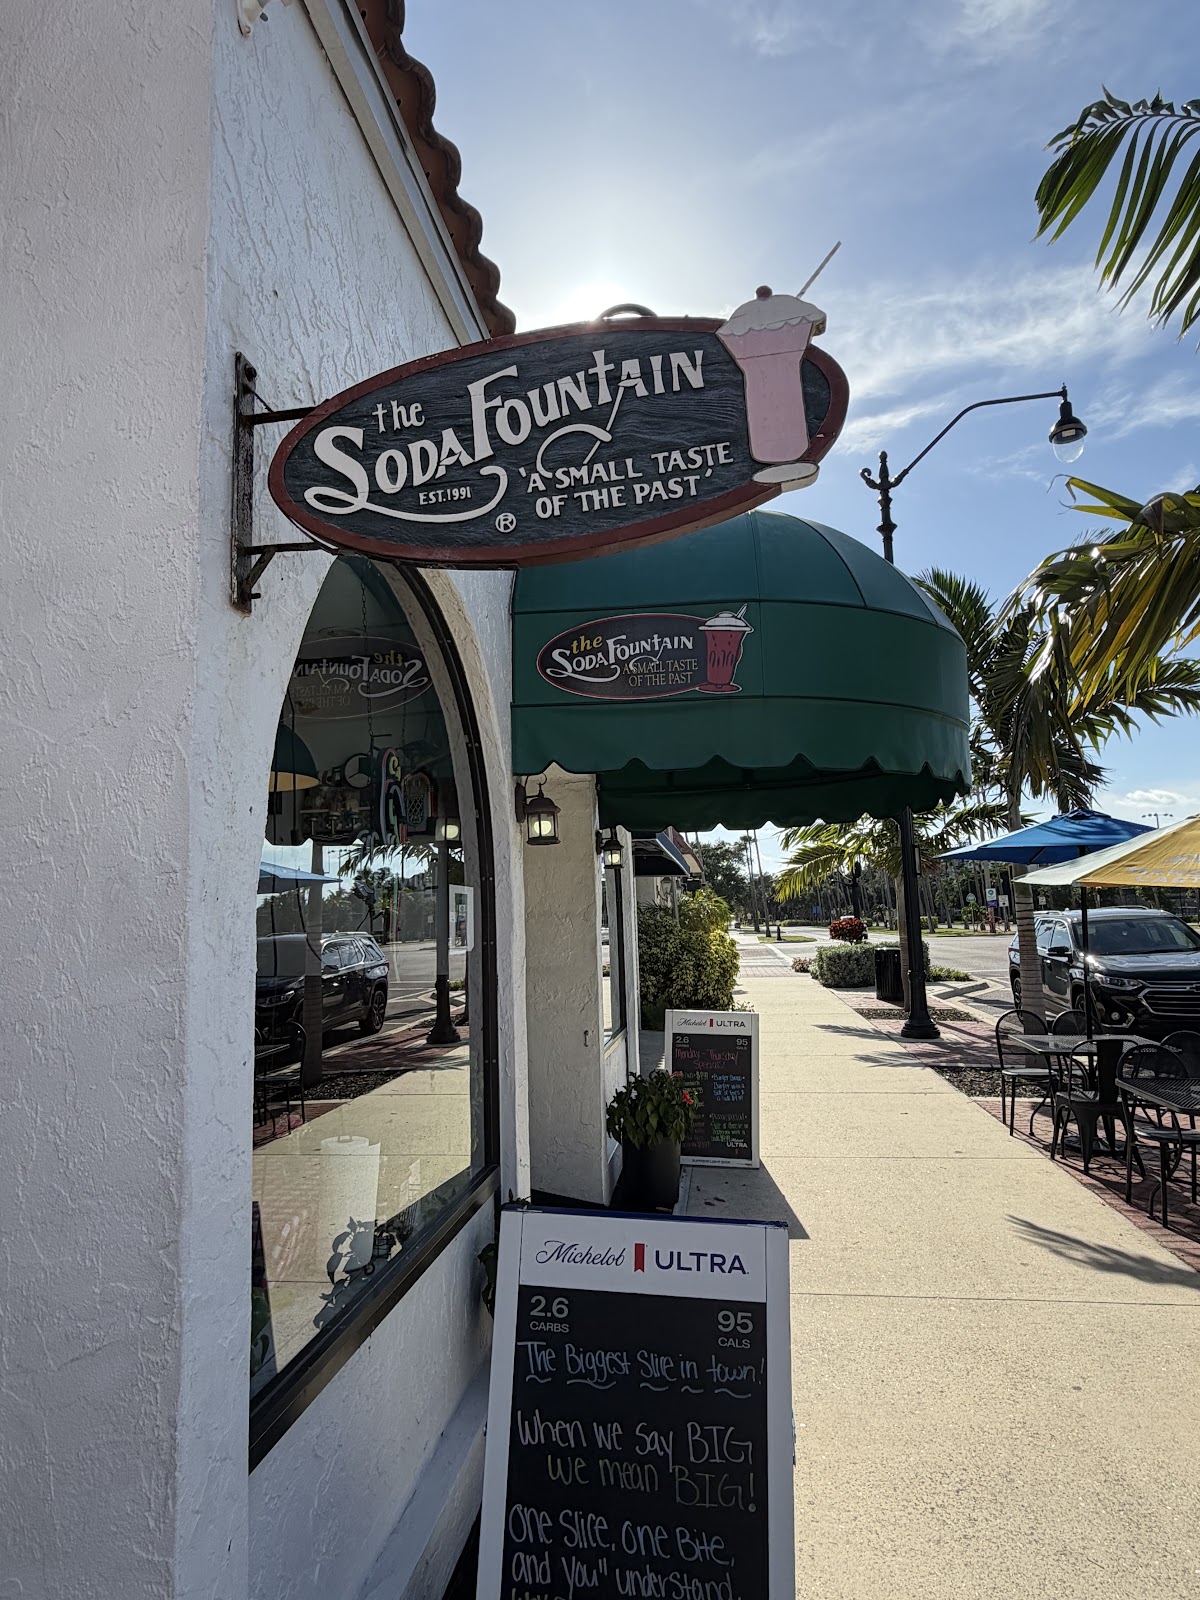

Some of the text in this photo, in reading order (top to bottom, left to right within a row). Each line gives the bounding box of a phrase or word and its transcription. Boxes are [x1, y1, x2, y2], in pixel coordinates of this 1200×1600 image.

[373, 400, 426, 432] the
[554, 457, 644, 487] SMALL
[650, 442, 735, 470] TASTE
[418, 486, 472, 506] EST.1991
[535, 495, 568, 519] OF
[574, 488, 627, 512] THE
[570, 635, 603, 655] the
[666, 658, 698, 671] TASTE
[628, 672, 693, 687] OF THE PAST
[716, 1020, 746, 1028] ULTRA
[675, 1036, 748, 1046] 2.6 95
[675, 1048, 700, 1061] Monday
[726, 1141, 748, 1149] ULTRA
[535, 1240, 748, 1275] Michelob ULTRA
[529, 1295, 754, 1334] 2.6 95
[529, 1321, 751, 1349] CARBS CALS
[517, 1341, 556, 1375] The
[565, 1343, 631, 1383] Biggest
[679, 1354, 698, 1380] in
[517, 1409, 587, 1449] When
[687, 1421, 753, 1464] BIG
[598, 1458, 658, 1492] mean
[671, 1465, 757, 1513] BIG!
[511, 1551, 551, 1584] and
